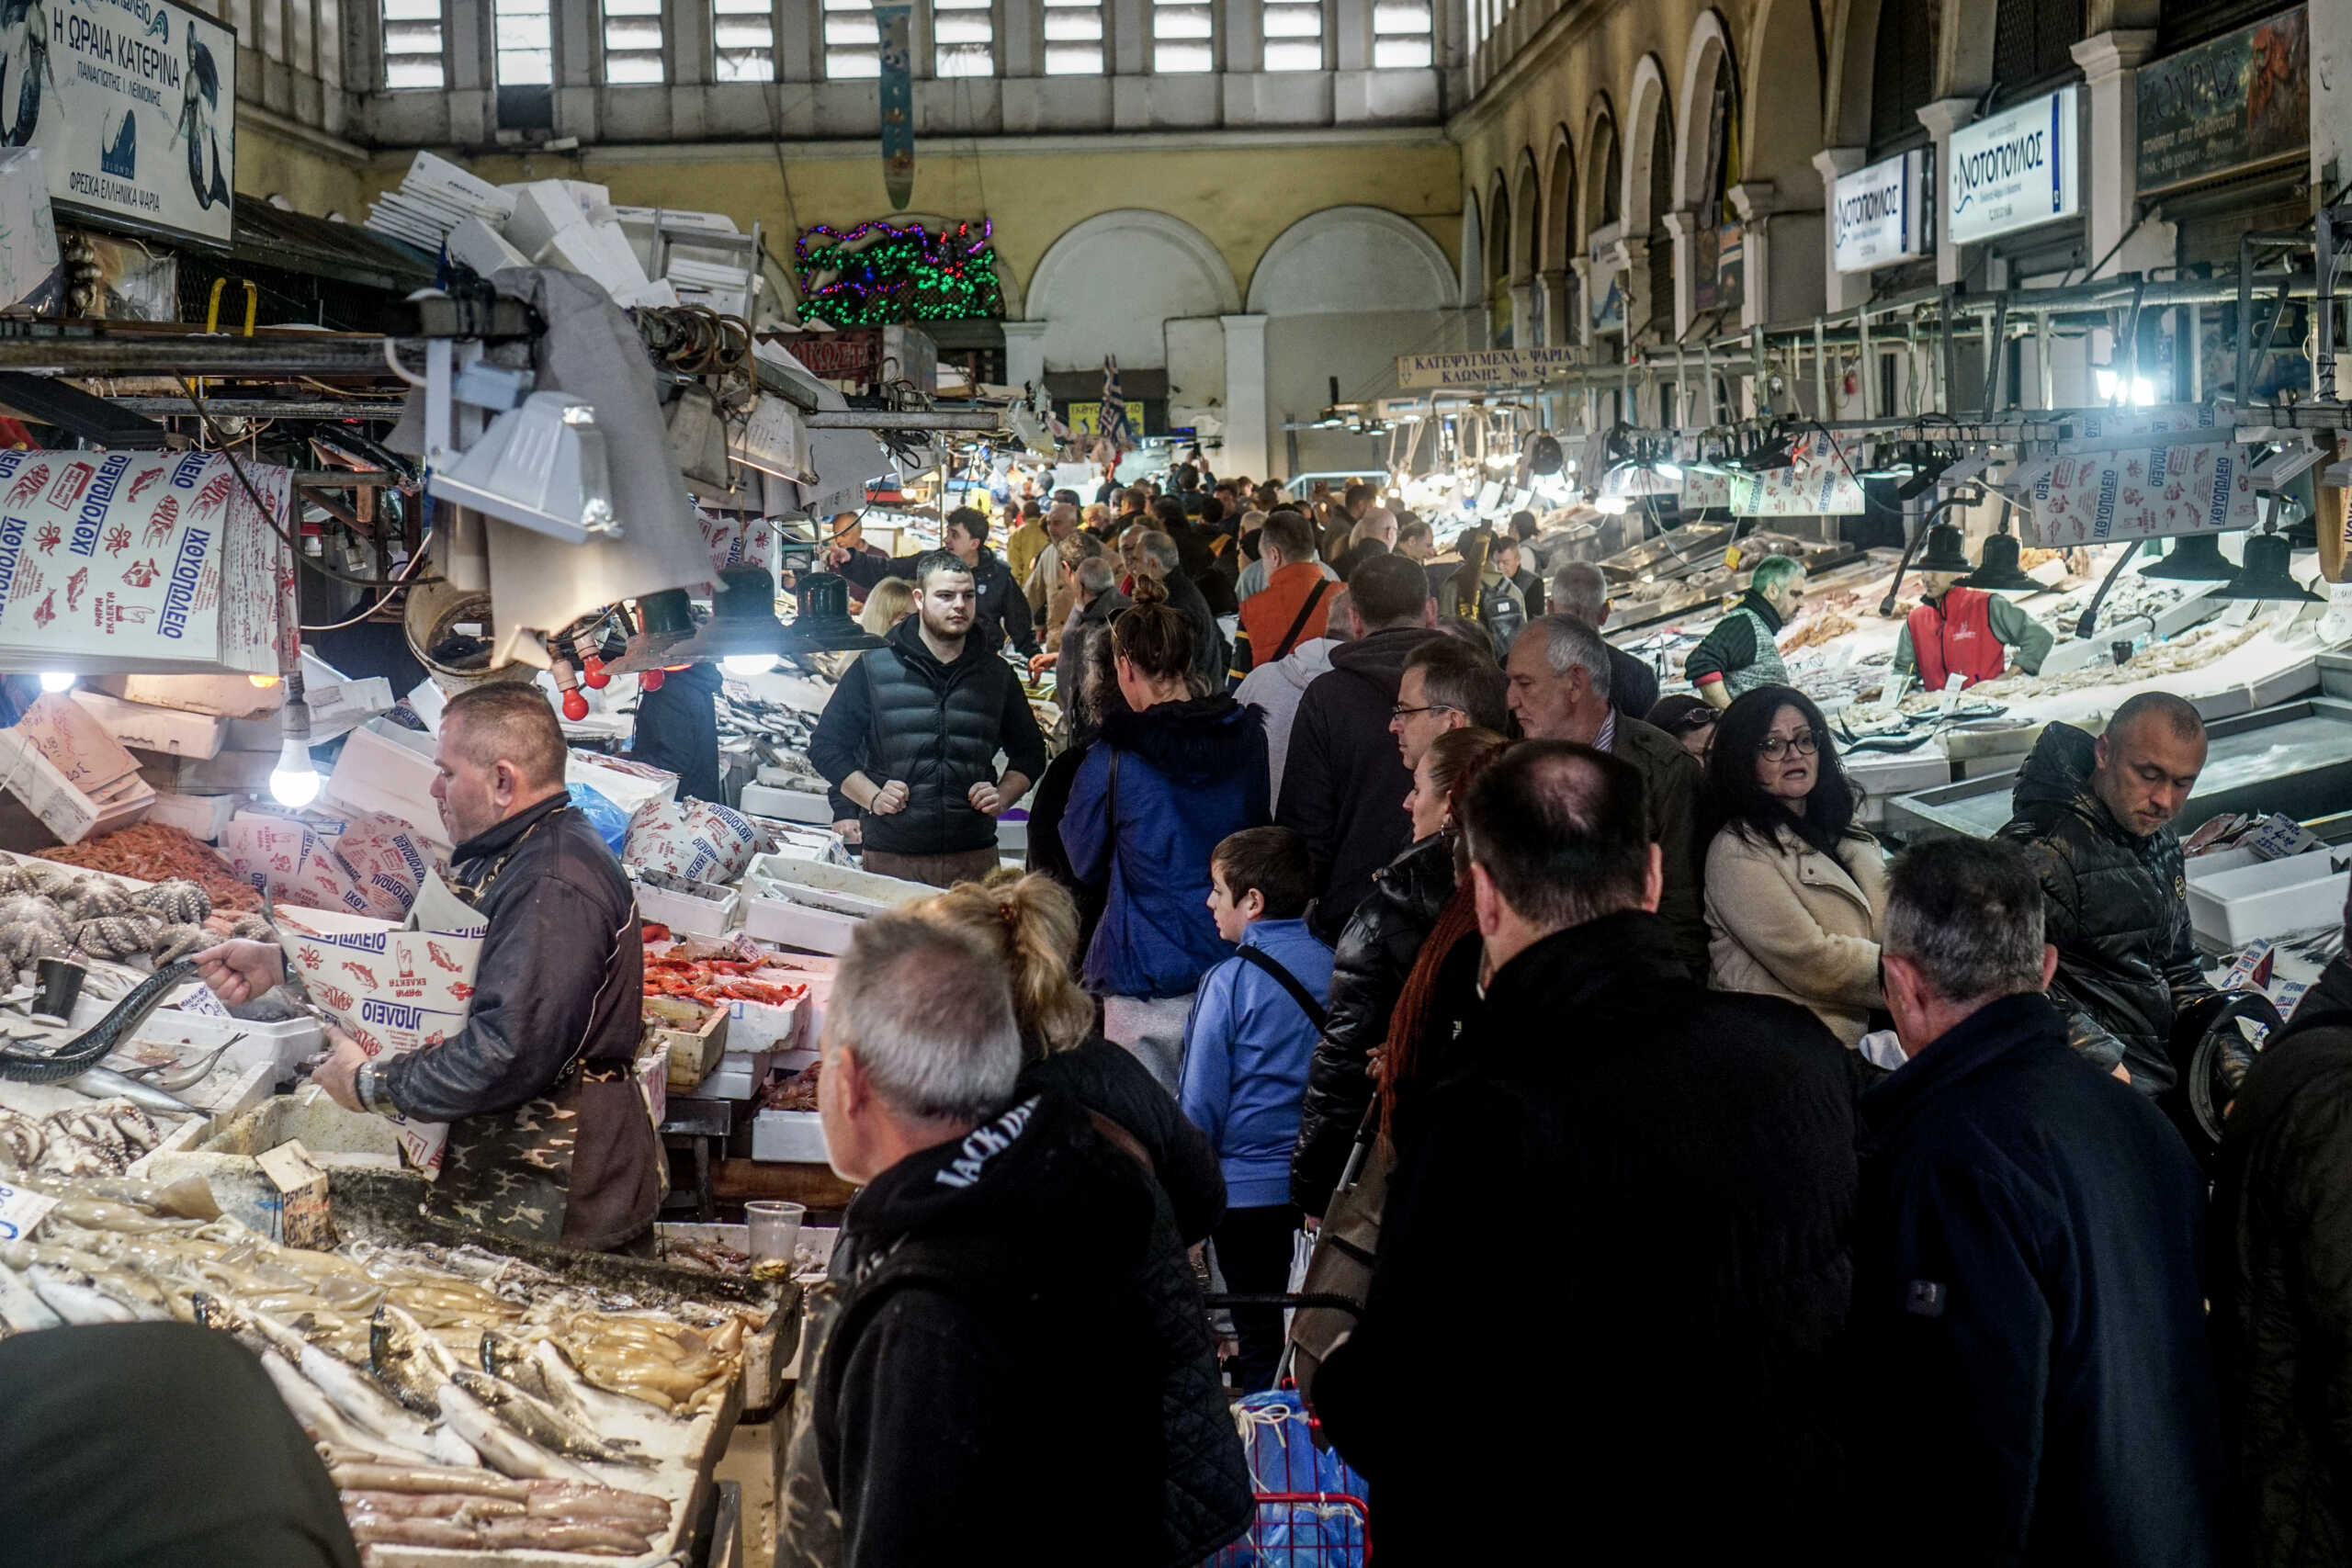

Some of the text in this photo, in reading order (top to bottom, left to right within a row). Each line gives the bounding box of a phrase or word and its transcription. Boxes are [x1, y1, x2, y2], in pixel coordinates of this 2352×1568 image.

[53, 7, 180, 90] Η ΩΡΑΙΑ ΚΑΤΕΡΙΝΑ
[70, 172, 160, 213] ΦΡΕΣΚΑ ΕΛΛΗΝΙΚΑ ΨΑΡΙΑ
[1959, 130, 2043, 200] ΝΟΤΟΠΟΥΛΟΣ
[1530, 348, 1573, 363] ΨΑΡΙΑ
[69, 455, 128, 556] ΙΧΘΥΟΠΩΛΕΙΟ
[2093, 469, 2114, 538] ΙΧΘΥΟΠΩΛΕΙΟ
[2210, 457, 2230, 525] ΙΧΘΥΟΠΩΛΕΙΟ
[163, 527, 211, 638] ΙΧΘΥΟΠΩΛΕΙΟ
[707, 804, 753, 843] ΙΧΘΥΟΠΩΛΕΙΟ
